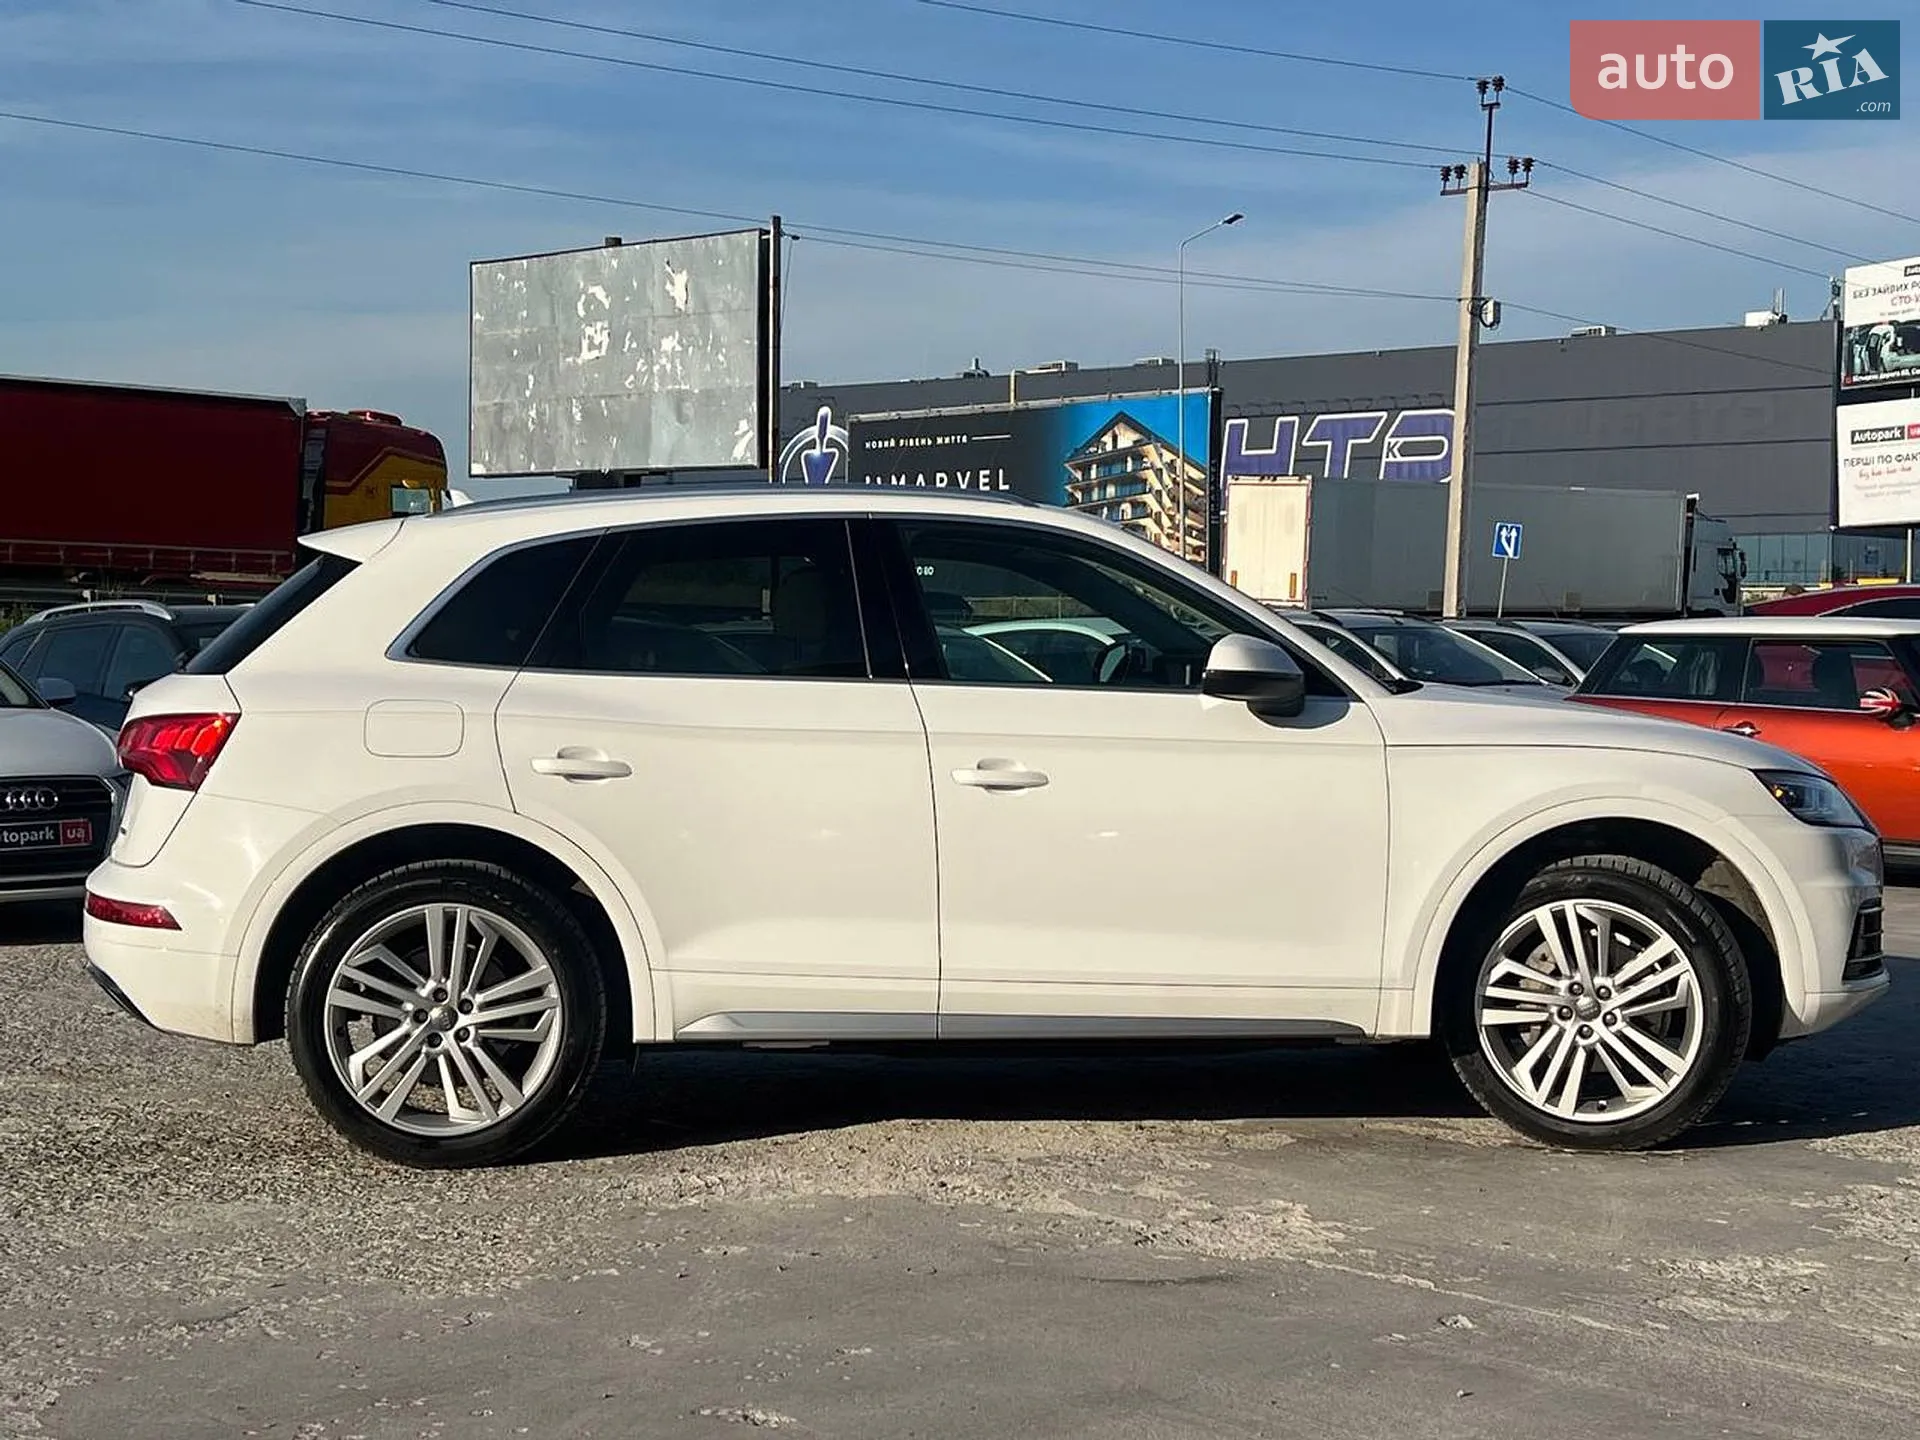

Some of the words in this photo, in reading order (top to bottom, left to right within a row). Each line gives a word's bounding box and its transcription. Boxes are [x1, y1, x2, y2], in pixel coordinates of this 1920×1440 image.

[1853, 426, 1902, 442] Autopark
[865, 437, 896, 449] НОВИЙ
[899, 436, 932, 447] РІВЕНЬ
[936, 434, 968, 445] ЖИТТЯ
[1843, 456, 1875, 468] ПЕРШІ
[1877, 454, 1893, 464] ПО
[66, 829, 86, 840] ua
